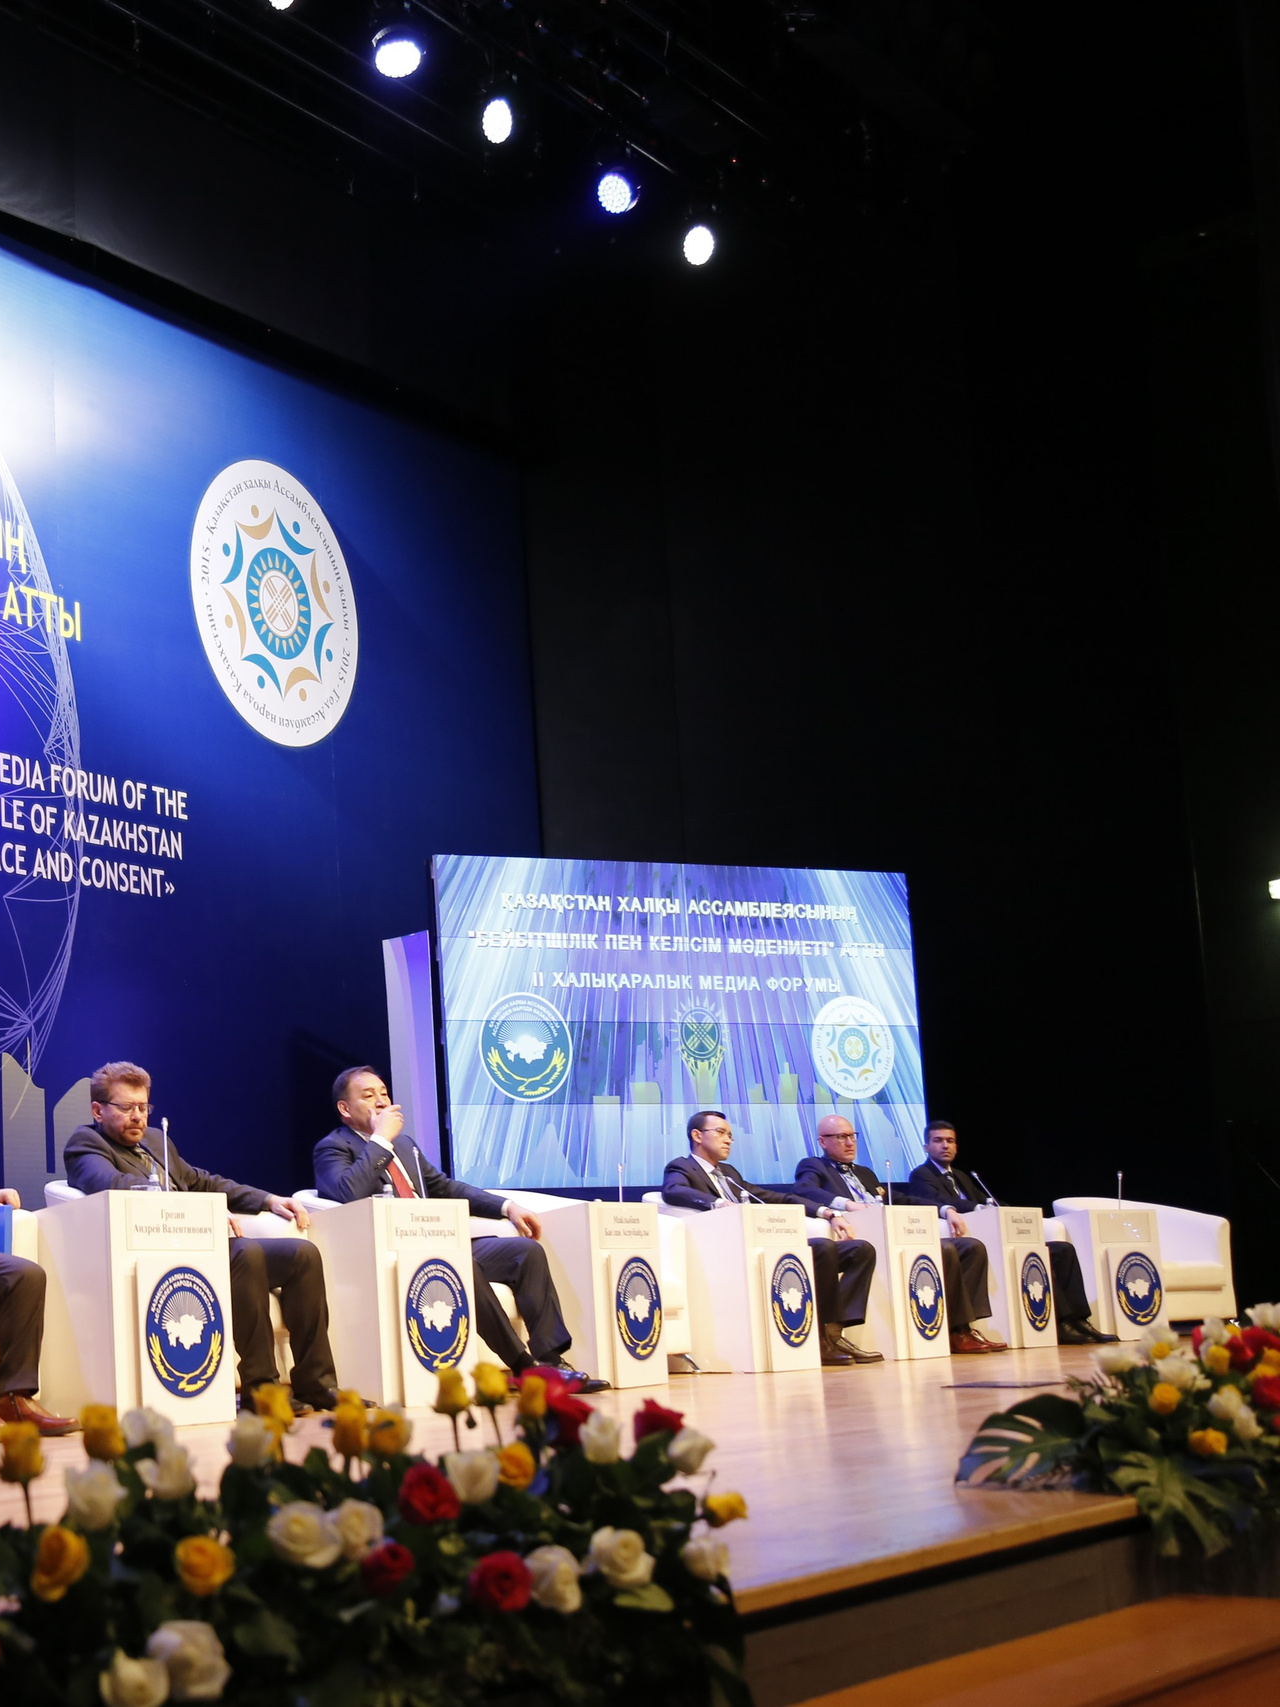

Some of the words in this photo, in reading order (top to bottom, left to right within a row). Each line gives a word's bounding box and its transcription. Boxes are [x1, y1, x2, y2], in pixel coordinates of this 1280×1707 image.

[2, 581, 81, 642] АТТЫ
[50, 764, 118, 806] FORUM
[122, 779, 147, 810] OF
[151, 785, 189, 821] THE
[30, 802, 58, 837] OF
[63, 810, 183, 861] KAZAKHSTAN
[32, 847, 73, 883] AND
[78, 855, 176, 898] CONSENT»
[501, 892, 611, 913] ҚАЗАҚСТАН
[617, 896, 680, 917] ХАЛҚЫ
[688, 899, 858, 925] АССАМБЛЕЯСЫНЫҢ
[605, 934, 642, 951] ПЕН
[649, 935, 722, 954] КЕЛІСІМ
[839, 941, 886, 959] АТТЫ
[699, 975, 761, 994] МЕДИА
[766, 976, 841, 993] ФОРУМЫ
[134, 1223, 160, 1236] Андрей
[162, 1223, 212, 1234] Валентинович
[160, 1208, 185, 1222] Грозин
